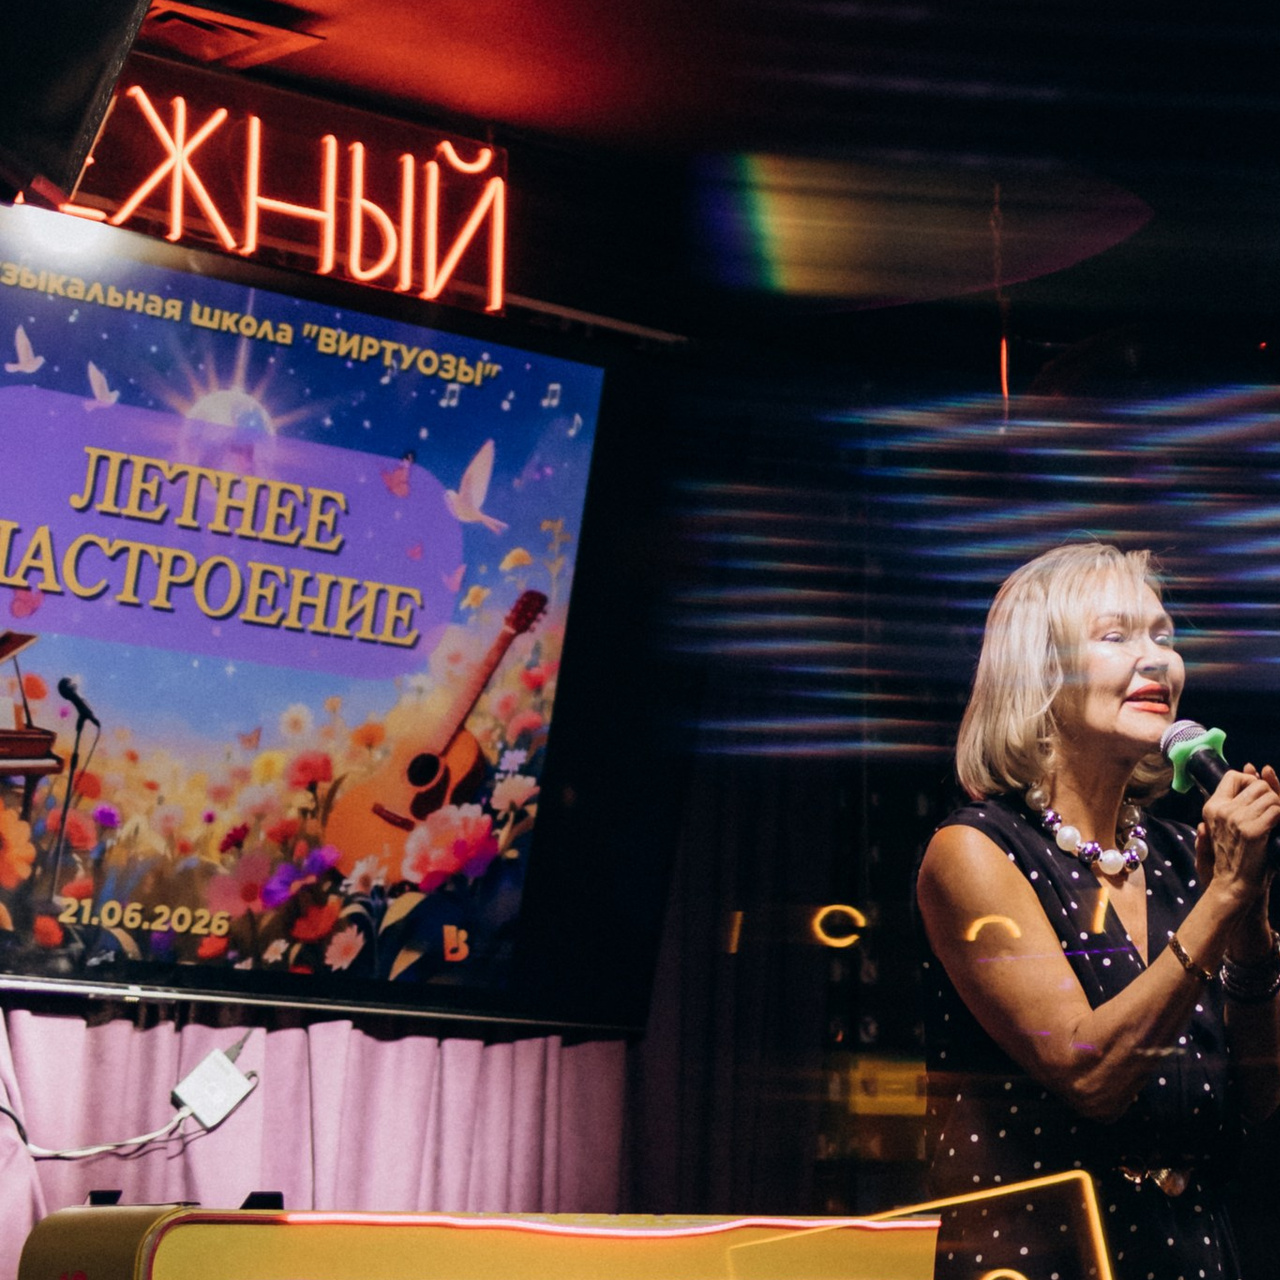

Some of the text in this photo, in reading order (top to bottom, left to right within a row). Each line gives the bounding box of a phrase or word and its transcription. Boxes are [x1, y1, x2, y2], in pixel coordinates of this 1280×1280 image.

[58, 84, 506, 313] ЖНЫЙ
[0, 262, 502, 387] зыкальная школа "ВИРТУОЗЫ"
[69, 445, 349, 553] ЛЕТНЕЕ
[58, 897, 231, 937] 21.06.2026
